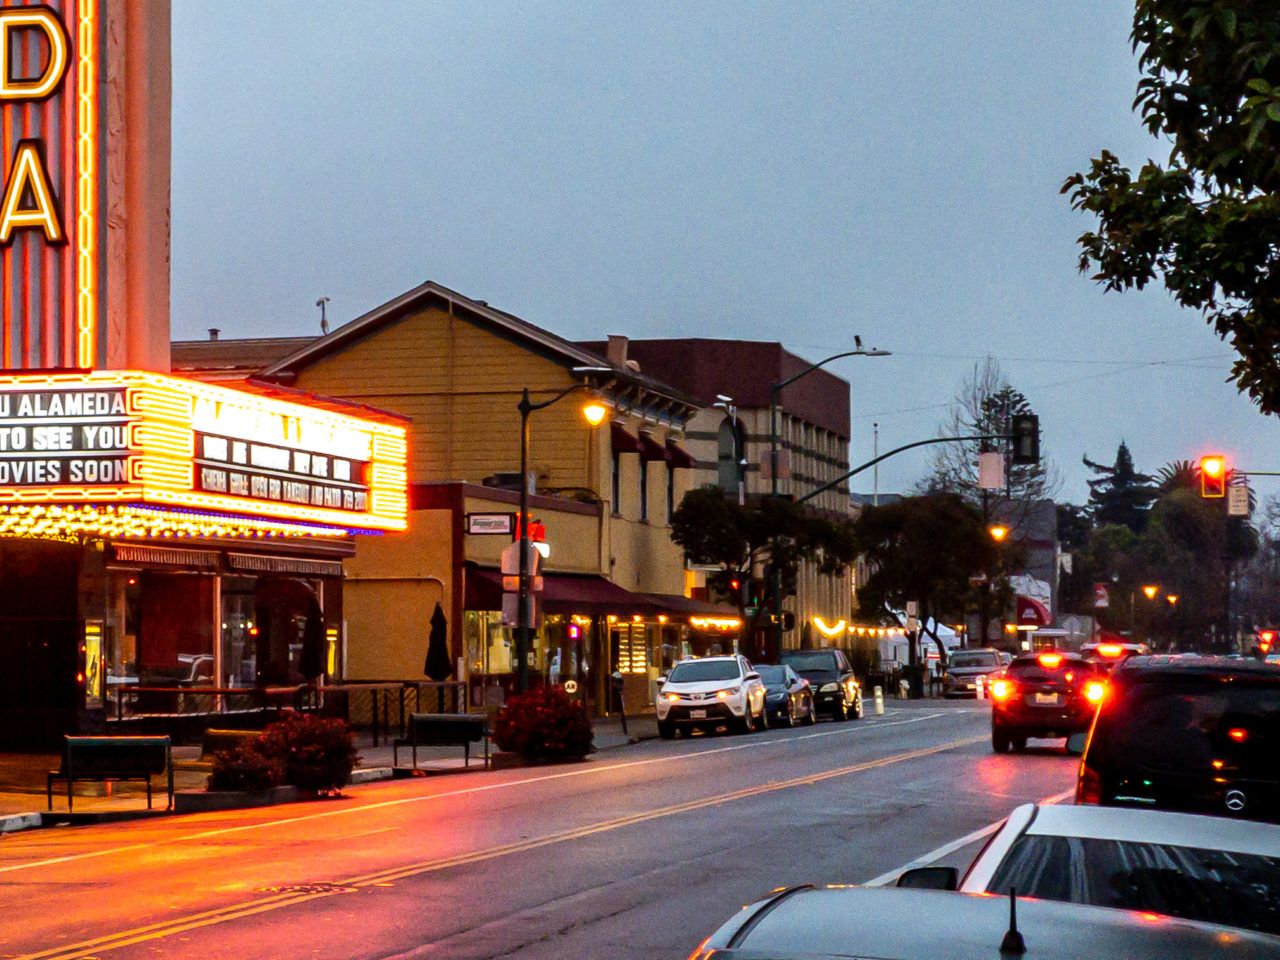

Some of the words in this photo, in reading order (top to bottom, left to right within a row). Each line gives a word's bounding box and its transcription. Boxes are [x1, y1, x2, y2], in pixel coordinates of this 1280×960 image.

[17, 392, 127, 417] ALAMEDA
[32, 426, 73, 450] SEE
[83, 426, 127, 449] YOU
[70, 460, 129, 483] SOON
